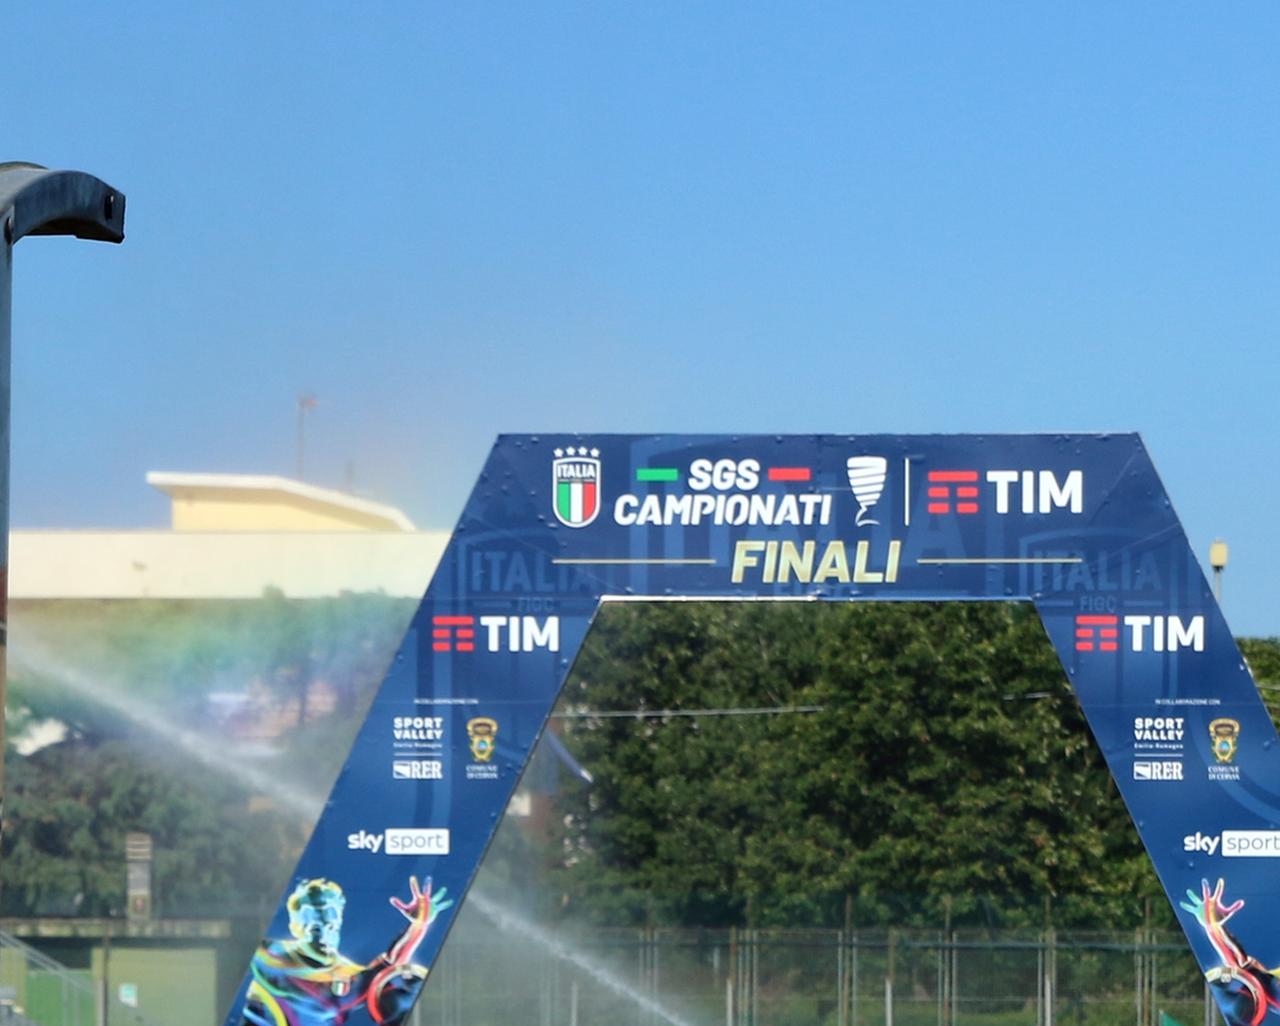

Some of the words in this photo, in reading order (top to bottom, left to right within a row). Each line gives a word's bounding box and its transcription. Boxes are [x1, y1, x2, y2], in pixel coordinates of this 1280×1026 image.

[557, 463, 596, 478] ITALIA
[688, 458, 761, 491] SGS
[986, 470, 1083, 514] TIM
[613, 494, 832, 526] CAMPIONATI
[731, 540, 902, 584] FINALI
[480, 616, 559, 652] TIM
[1124, 615, 1205, 652] TIM
[393, 717, 443, 729] SPORT
[393, 729, 443, 740] VALLEY
[1134, 717, 1184, 729] SPORT
[1134, 729, 1184, 740] VALLEY
[411, 760, 443, 779] RER
[1152, 762, 1184, 780] RER
[347, 830, 384, 853] sky
[390, 834, 443, 851] sport
[1183, 831, 1220, 855] sky
[1226, 836, 1280, 853] sport
